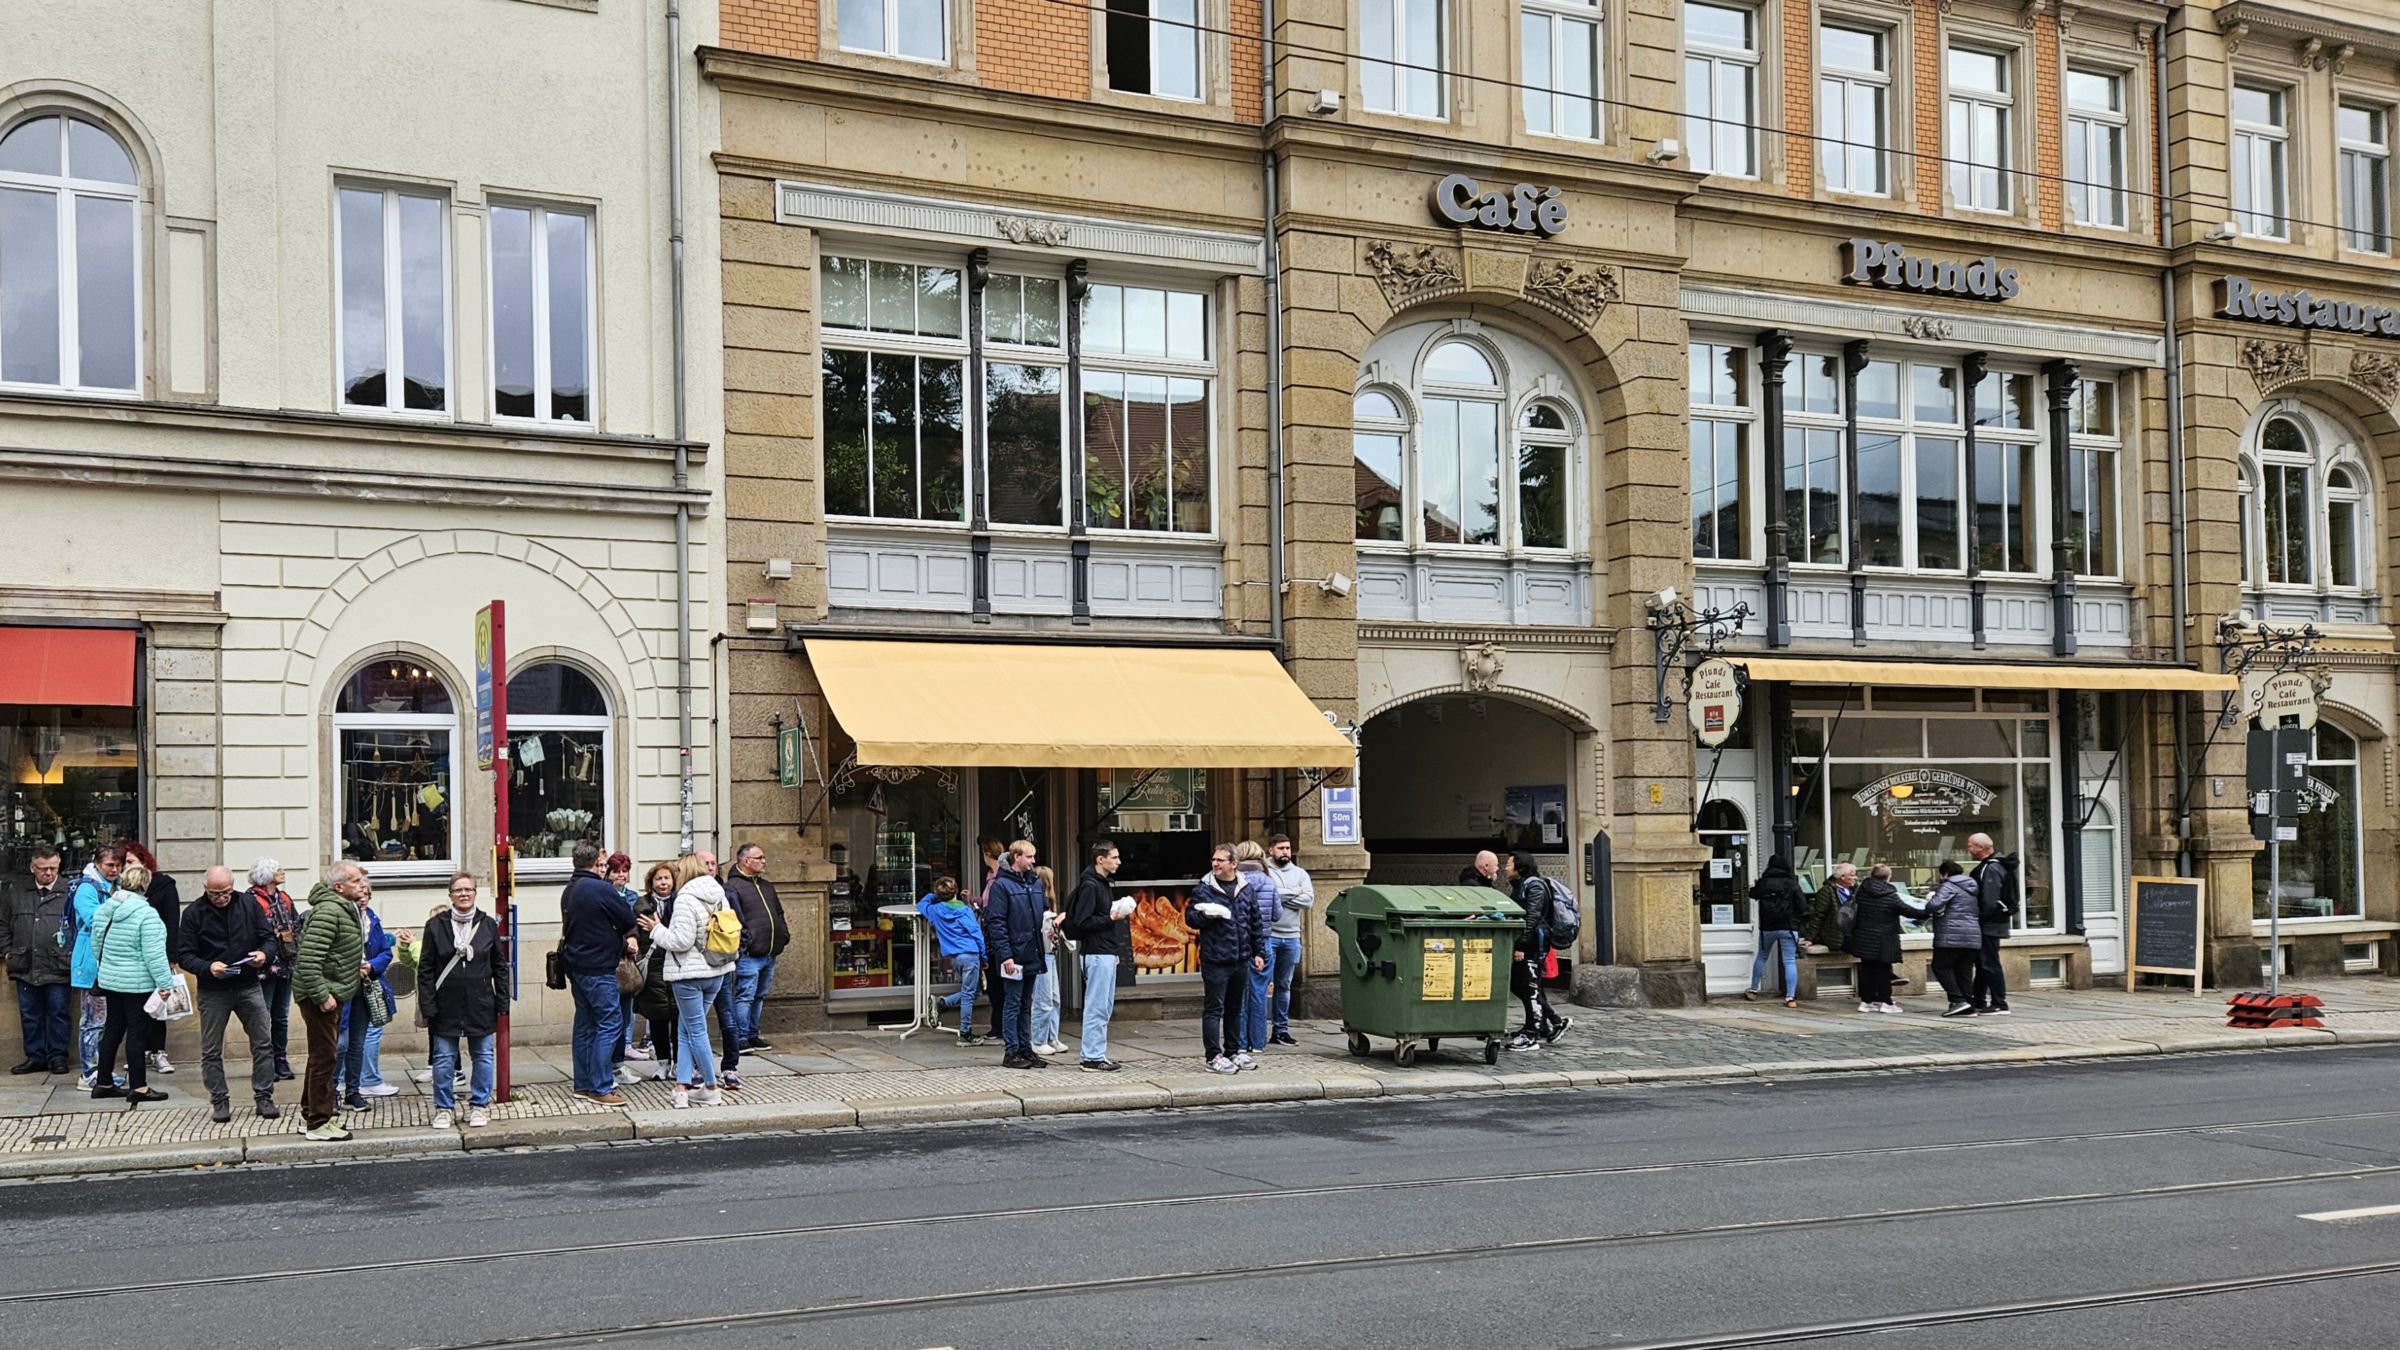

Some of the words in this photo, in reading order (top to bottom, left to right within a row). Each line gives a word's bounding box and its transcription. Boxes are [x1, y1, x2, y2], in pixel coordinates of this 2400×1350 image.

[1436, 173, 1569, 235] Café
[1849, 237, 2022, 299] Pfunds
[2224, 274, 2400, 336] Restaura
[1699, 667, 1727, 680] Pfunds
[1705, 678, 1721, 690] Café
[2271, 678, 2304, 691] Pfunds
[1695, 689, 1733, 700] Restaurant
[2279, 688, 2297, 700] Café
[2267, 697, 2311, 709] Restaurant
[1931, 771, 1966, 788] GEBRÜDER
[1965, 781, 1988, 800] PFUND
[2314, 780, 2333, 799] PFUND
[1332, 812, 1350, 822] 50m
